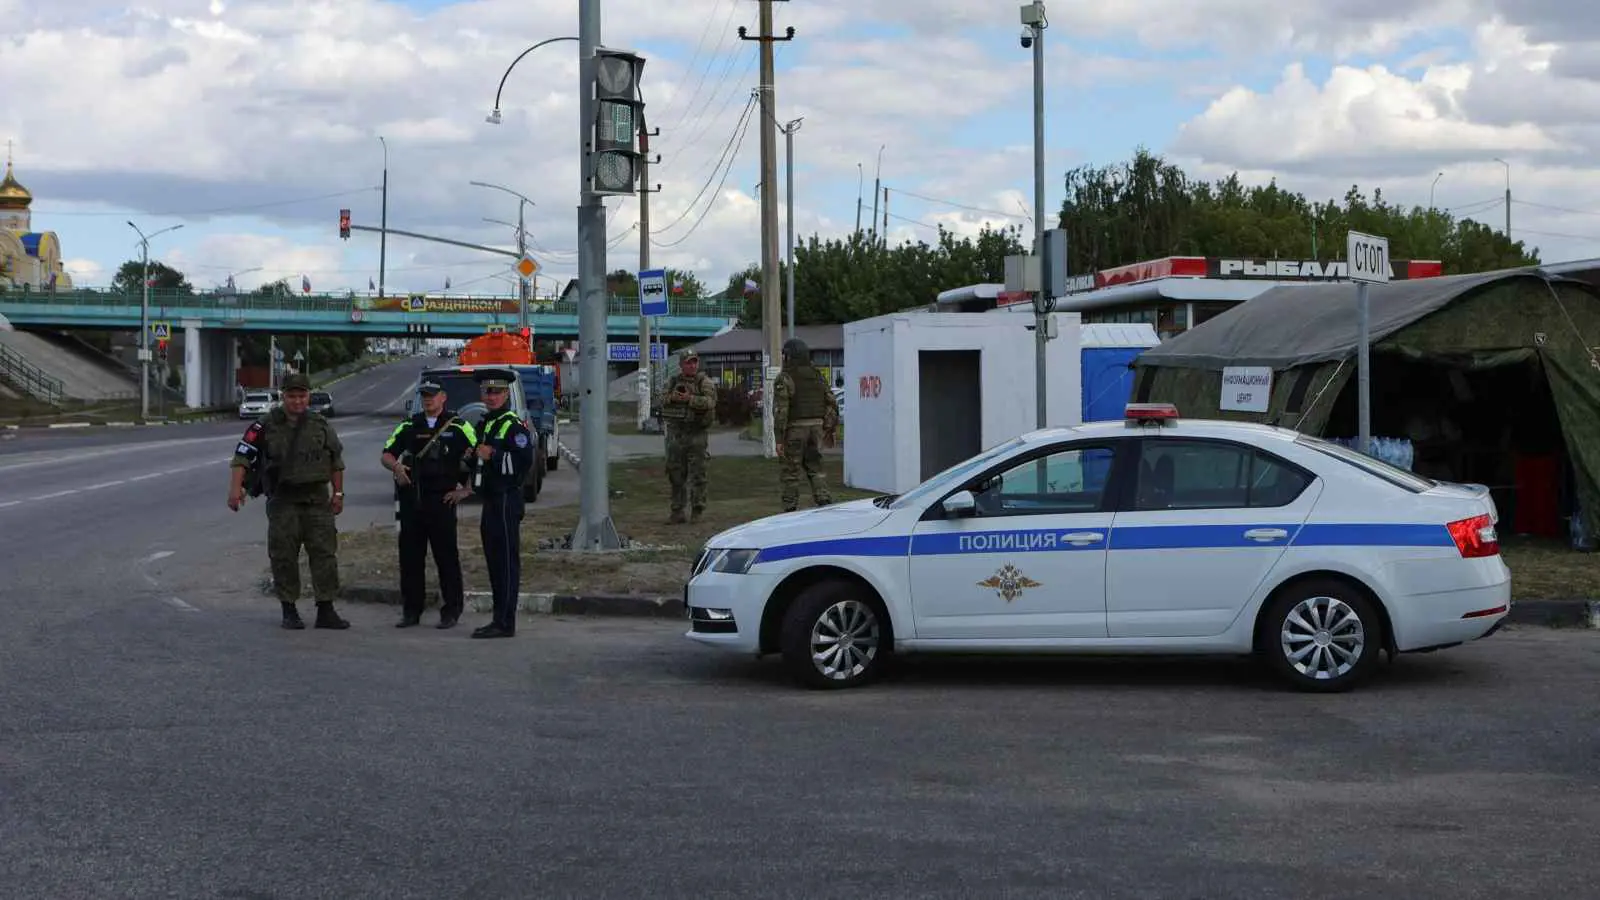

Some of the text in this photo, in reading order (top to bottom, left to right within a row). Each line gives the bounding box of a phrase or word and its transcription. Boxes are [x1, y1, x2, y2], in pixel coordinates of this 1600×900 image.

[1355, 241, 1384, 275] СТОП
[1220, 259, 1395, 278] РЫБАЛ
[424, 300, 502, 311] РАЗДНИКОМ!
[959, 533, 1056, 551] ПОЛИЦИЯ
